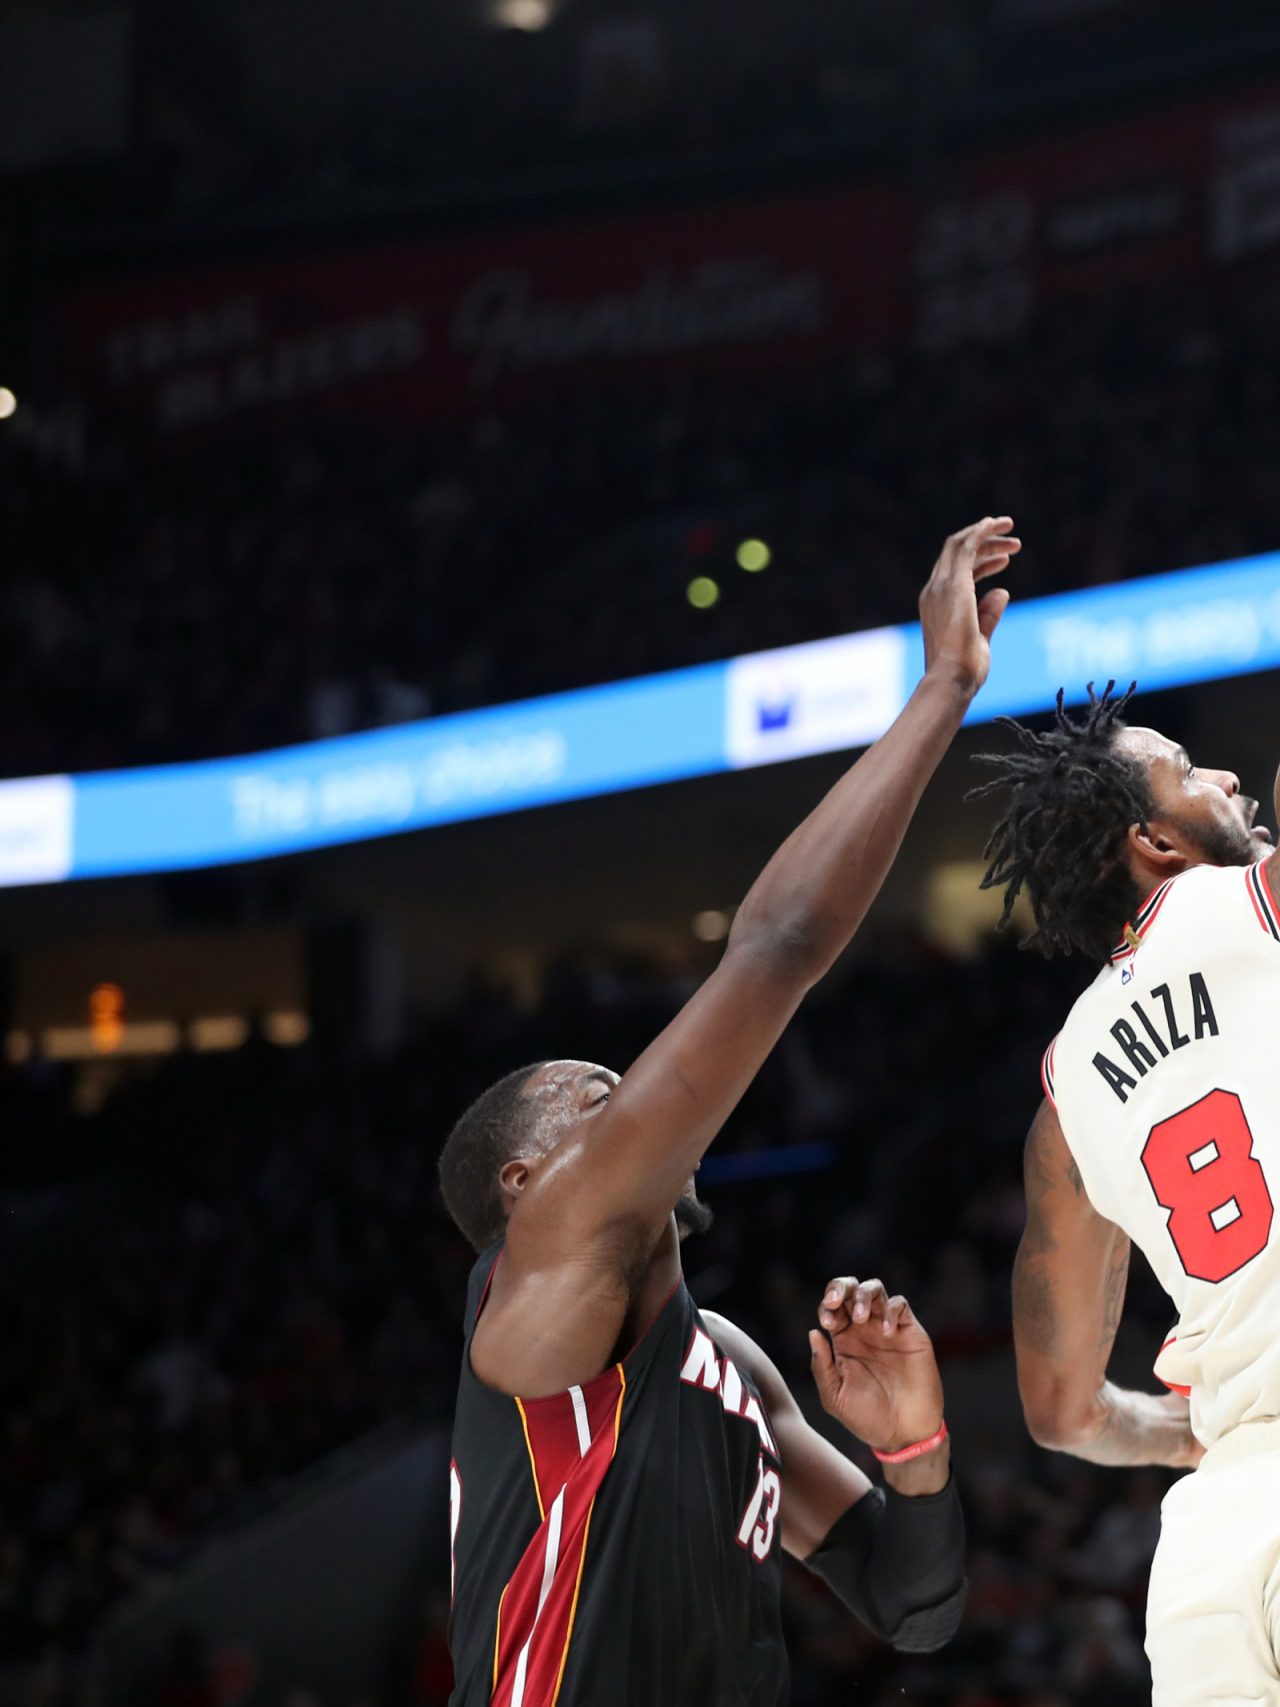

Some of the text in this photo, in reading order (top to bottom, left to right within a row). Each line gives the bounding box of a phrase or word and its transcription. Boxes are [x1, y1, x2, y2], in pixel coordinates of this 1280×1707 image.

[1042, 617, 1136, 674] The
[232, 775, 309, 835] The
[1092, 972, 1219, 1104] ARIZA
[1140, 1087, 1274, 1284] 8
[736, 1457, 782, 1563] 13
